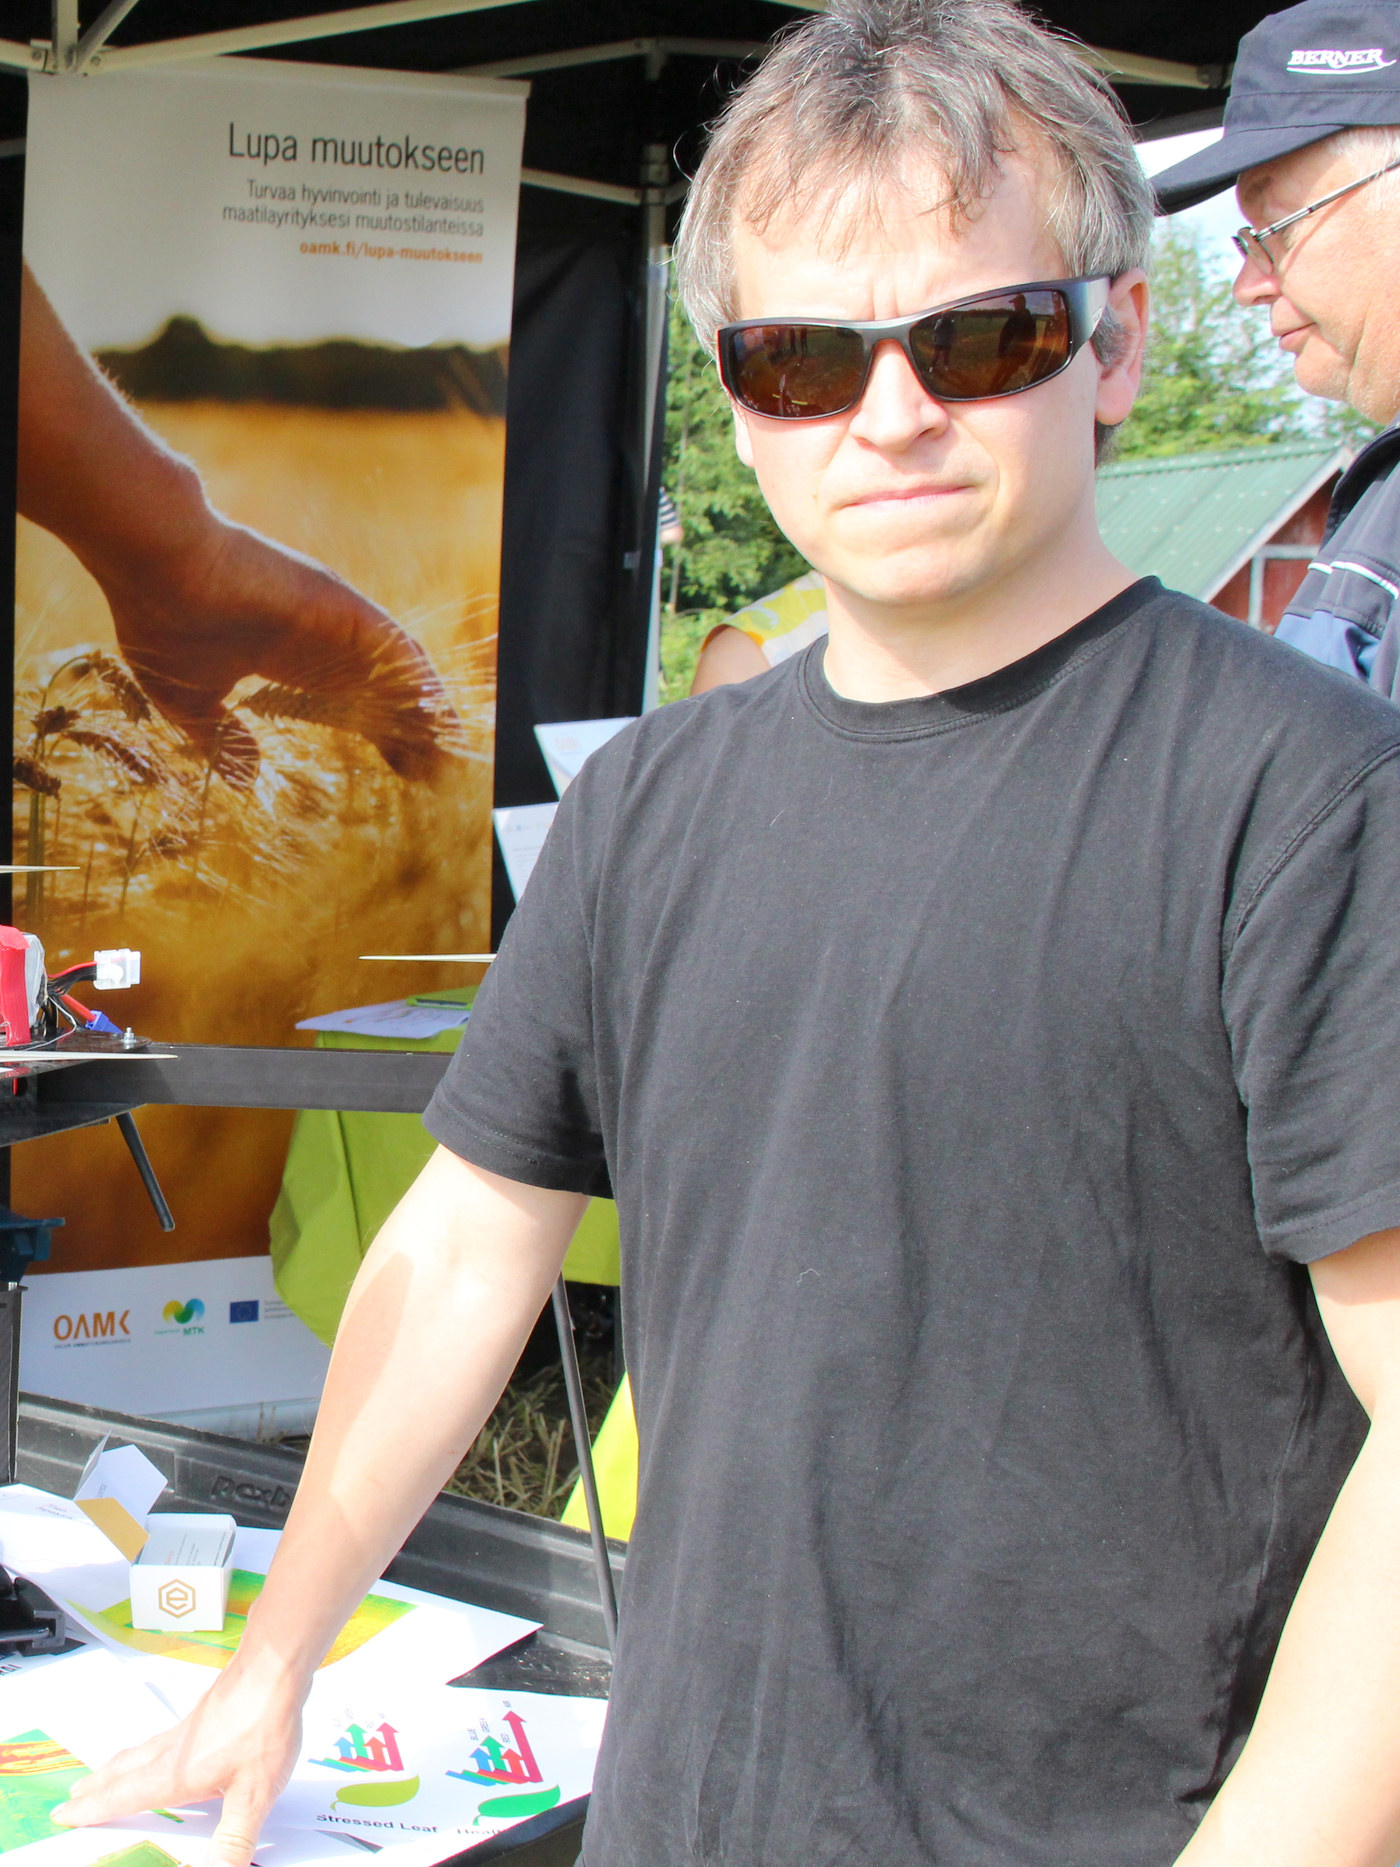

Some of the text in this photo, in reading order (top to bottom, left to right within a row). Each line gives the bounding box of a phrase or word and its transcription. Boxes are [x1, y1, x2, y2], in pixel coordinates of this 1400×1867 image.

[1287, 48, 1385, 69] BERNER
[229, 121, 484, 174] Lupa muutokseen
[247, 178, 485, 214] Turvaa hyvinvointi ja tulevaisuus
[222, 204, 484, 237] maatilayrityksesi muutostilanteissa
[299, 241, 483, 264] oamk.fi/lupa-muutokseen
[53, 1310, 130, 1341] OAMK
[183, 1326, 205, 1336] MTK
[316, 1813, 439, 1834] Stressed Leaf
